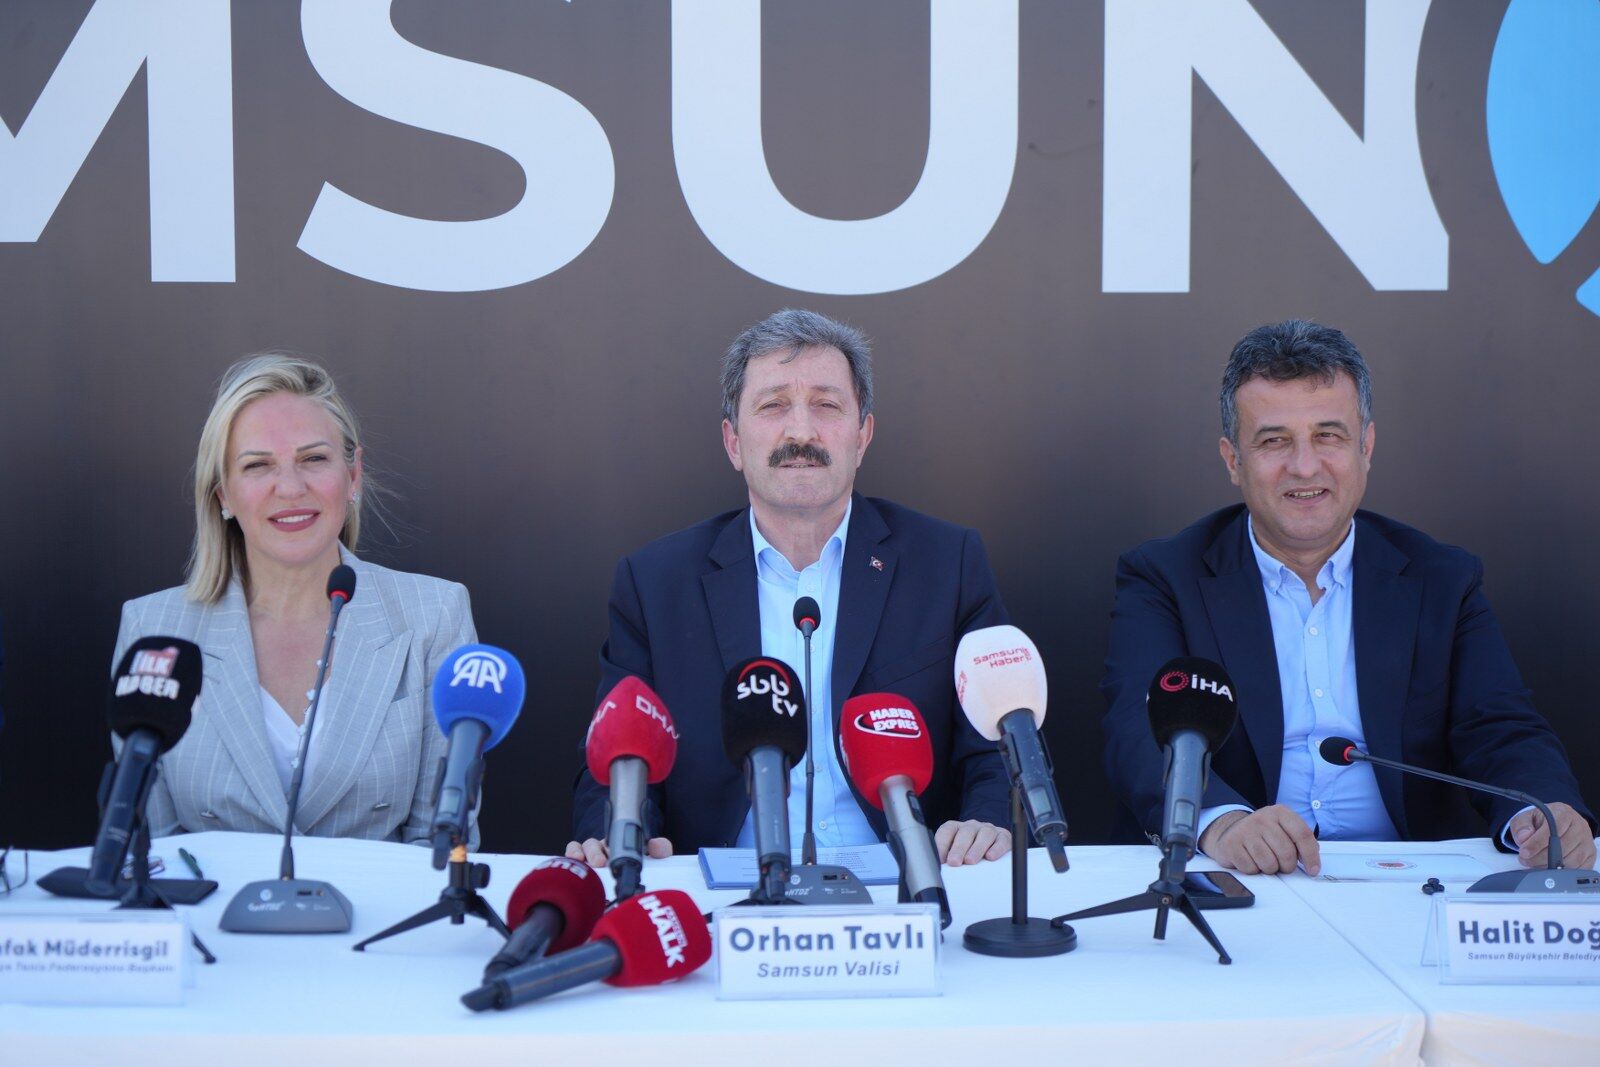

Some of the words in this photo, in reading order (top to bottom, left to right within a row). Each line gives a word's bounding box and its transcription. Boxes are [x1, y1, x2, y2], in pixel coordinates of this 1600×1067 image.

[973, 647, 1024, 665] Samsun
[990, 655, 1025, 668] Haber
[449, 657, 502, 694] AA
[737, 674, 790, 700] sbb
[771, 694, 799, 718] tv
[869, 707, 916, 721] HABER
[873, 718, 919, 731] EXPRES
[729, 927, 834, 952] Orhan
[843, 923, 923, 951] Tavlı
[1458, 920, 1535, 944] Halit
[1543, 920, 1600, 950] Doğ
[0, 938, 38, 956] fak
[1467, 952, 1505, 960] Samsun
[757, 963, 838, 978] Samsun
[844, 960, 900, 976] Valisi
